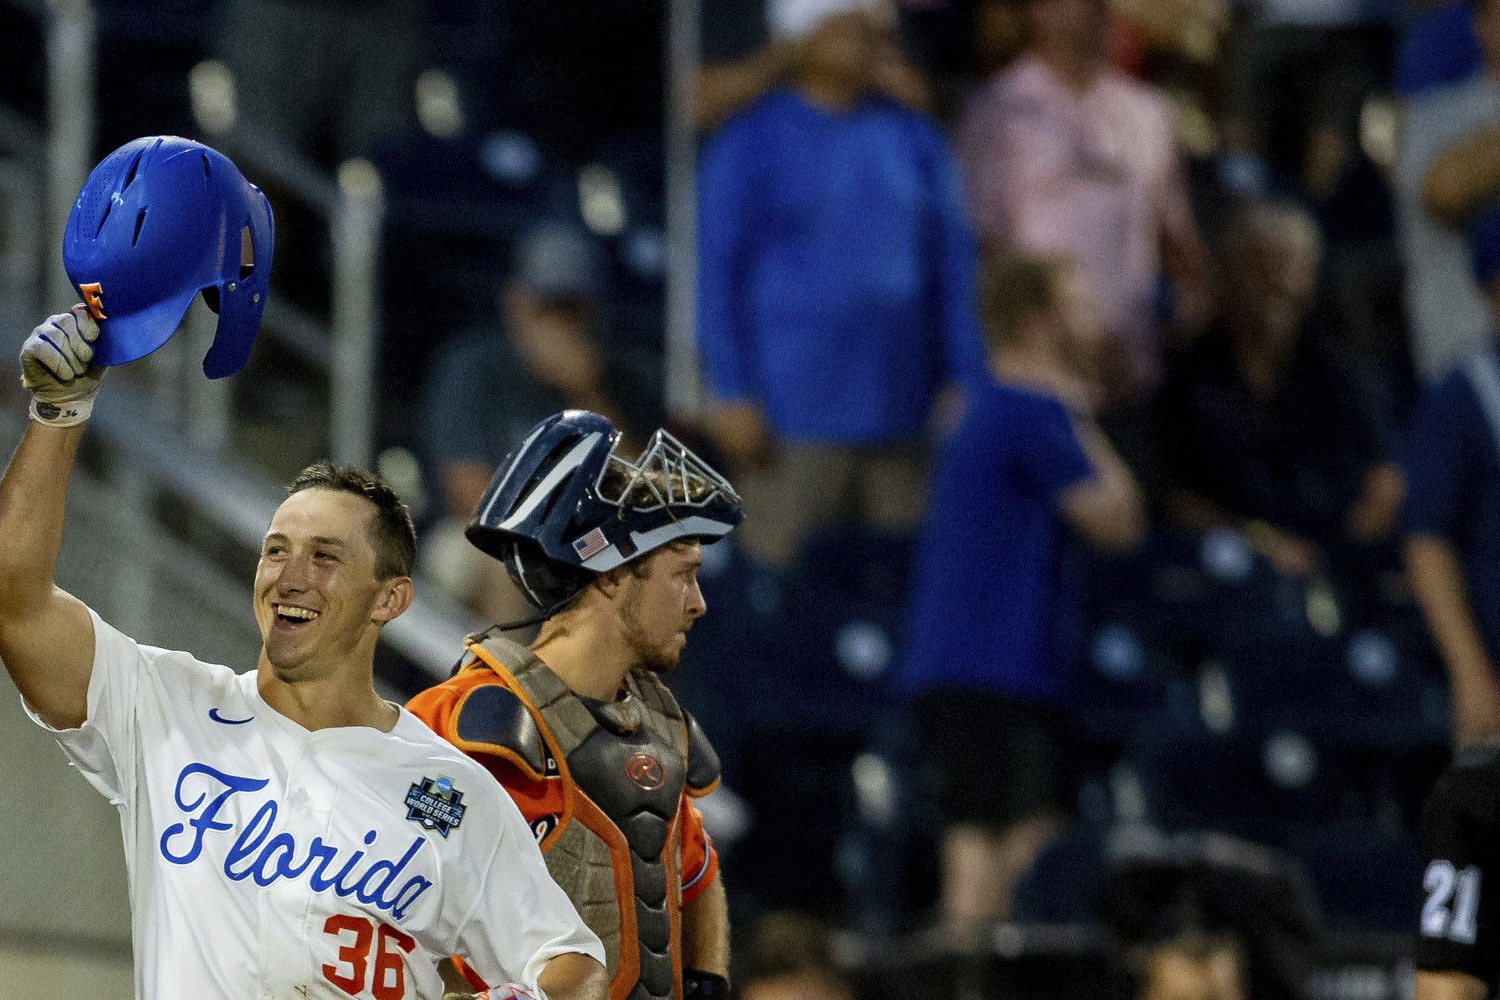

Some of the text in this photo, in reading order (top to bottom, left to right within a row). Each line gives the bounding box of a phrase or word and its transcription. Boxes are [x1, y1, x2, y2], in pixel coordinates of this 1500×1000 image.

[79, 282, 107, 319] F
[61, 408, 78, 418] 36
[406, 797, 434, 814] WORLD
[432, 809, 460, 827] SERIES
[420, 795, 453, 814] COLLEGE
[160, 762, 433, 921] Florida
[1421, 859, 1482, 945] 21
